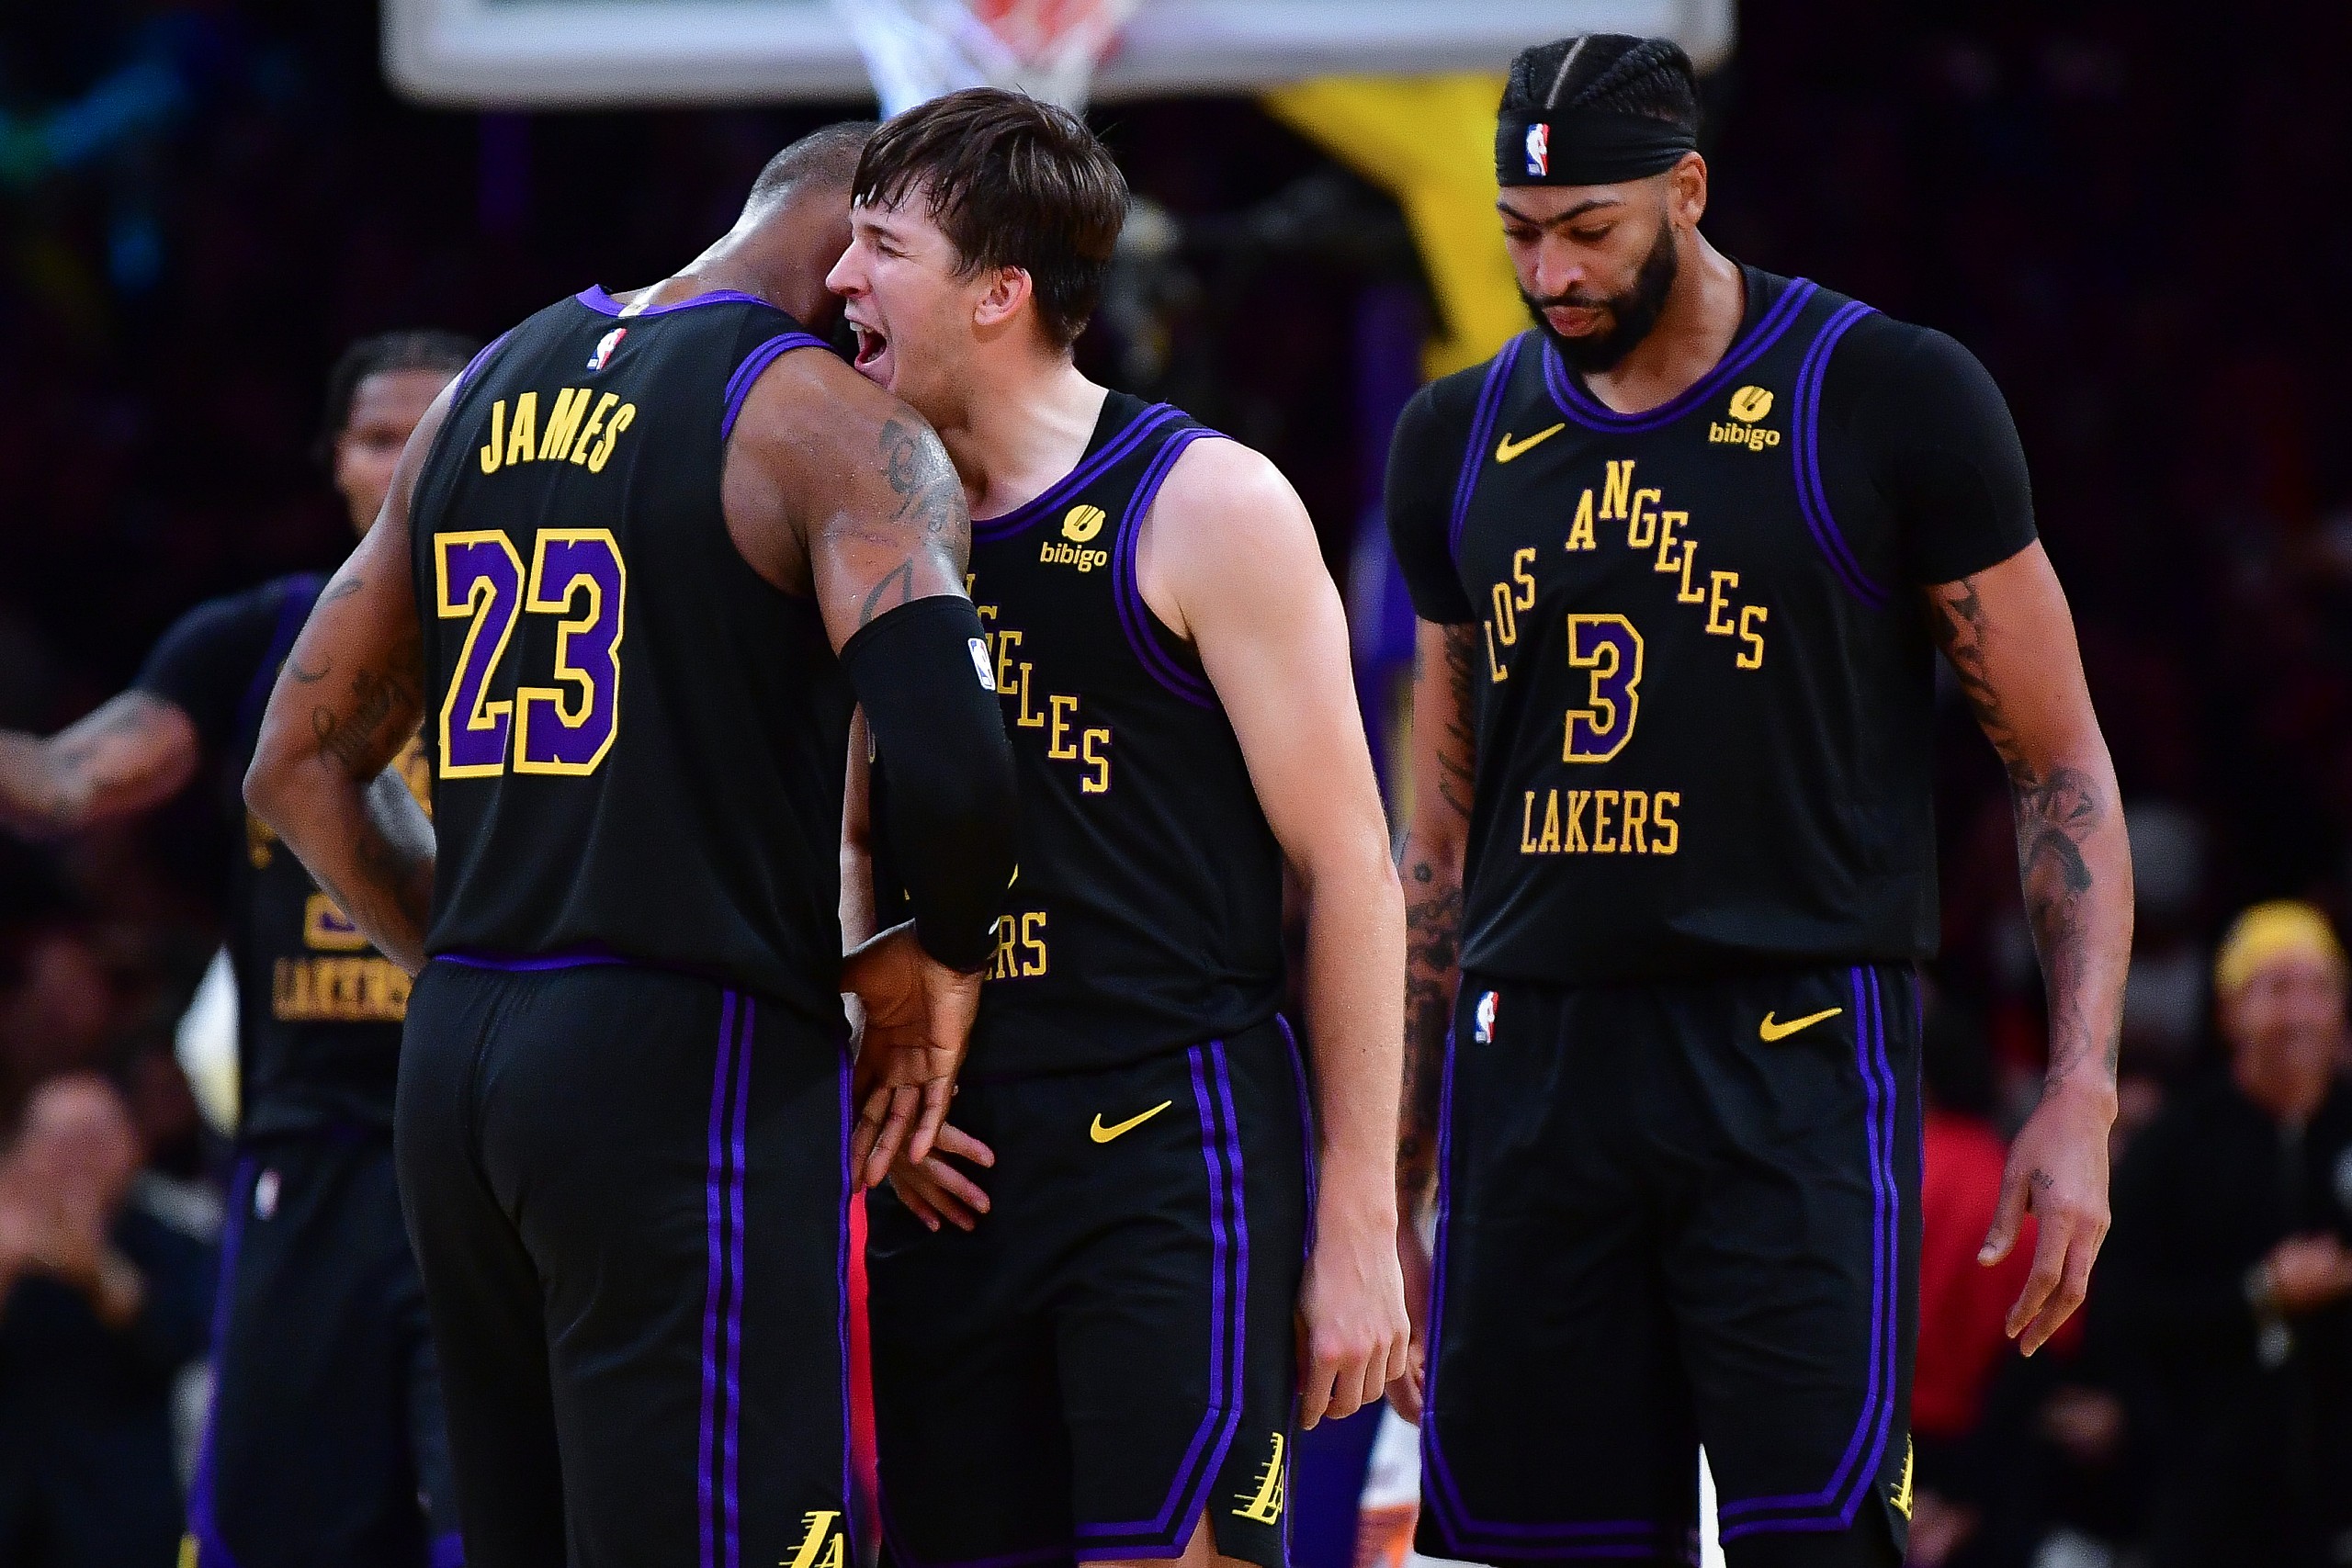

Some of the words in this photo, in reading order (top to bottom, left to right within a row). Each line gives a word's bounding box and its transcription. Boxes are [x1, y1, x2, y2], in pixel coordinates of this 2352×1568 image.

[481, 388, 636, 475] JAMES
[1709, 422, 1781, 451] bibigo
[1040, 541, 1108, 572] bibigo
[1484, 548, 1536, 683] LOS
[1566, 459, 1768, 670] ANGELES
[434, 528, 627, 780] 23
[1562, 614, 1645, 764] 3
[1521, 789, 1681, 855] LAKERS
